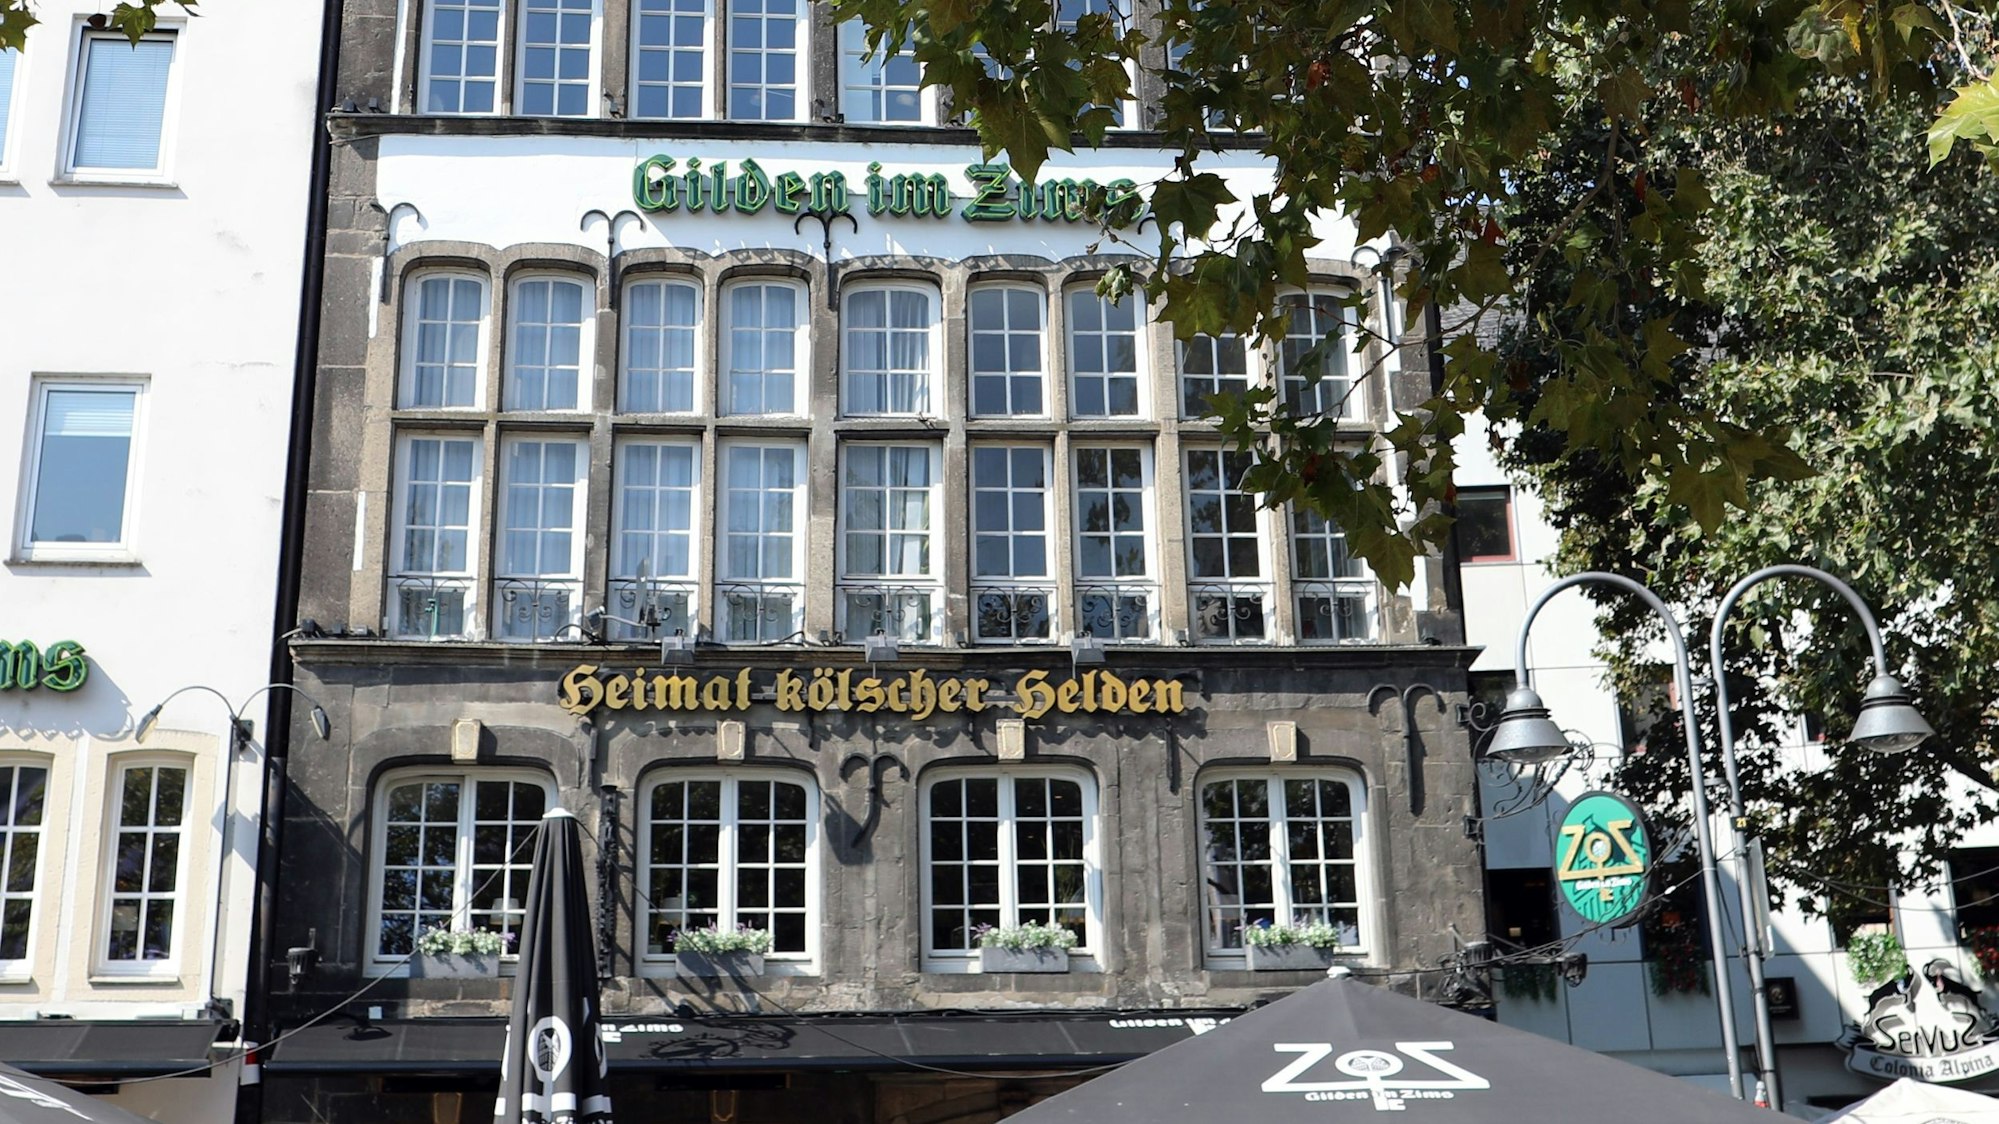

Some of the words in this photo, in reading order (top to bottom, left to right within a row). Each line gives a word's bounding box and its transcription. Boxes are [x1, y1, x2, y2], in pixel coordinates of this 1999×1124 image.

[632, 153, 849, 215] Gilden
[864, 160, 952, 218] im
[559, 664, 752, 716] Heimat
[774, 667, 990, 721] kölscher
[1013, 668, 1185, 720] Helden
[1869, 1056, 1934, 1078] Colonia
[1939, 1055, 1994, 1077] Alpina
